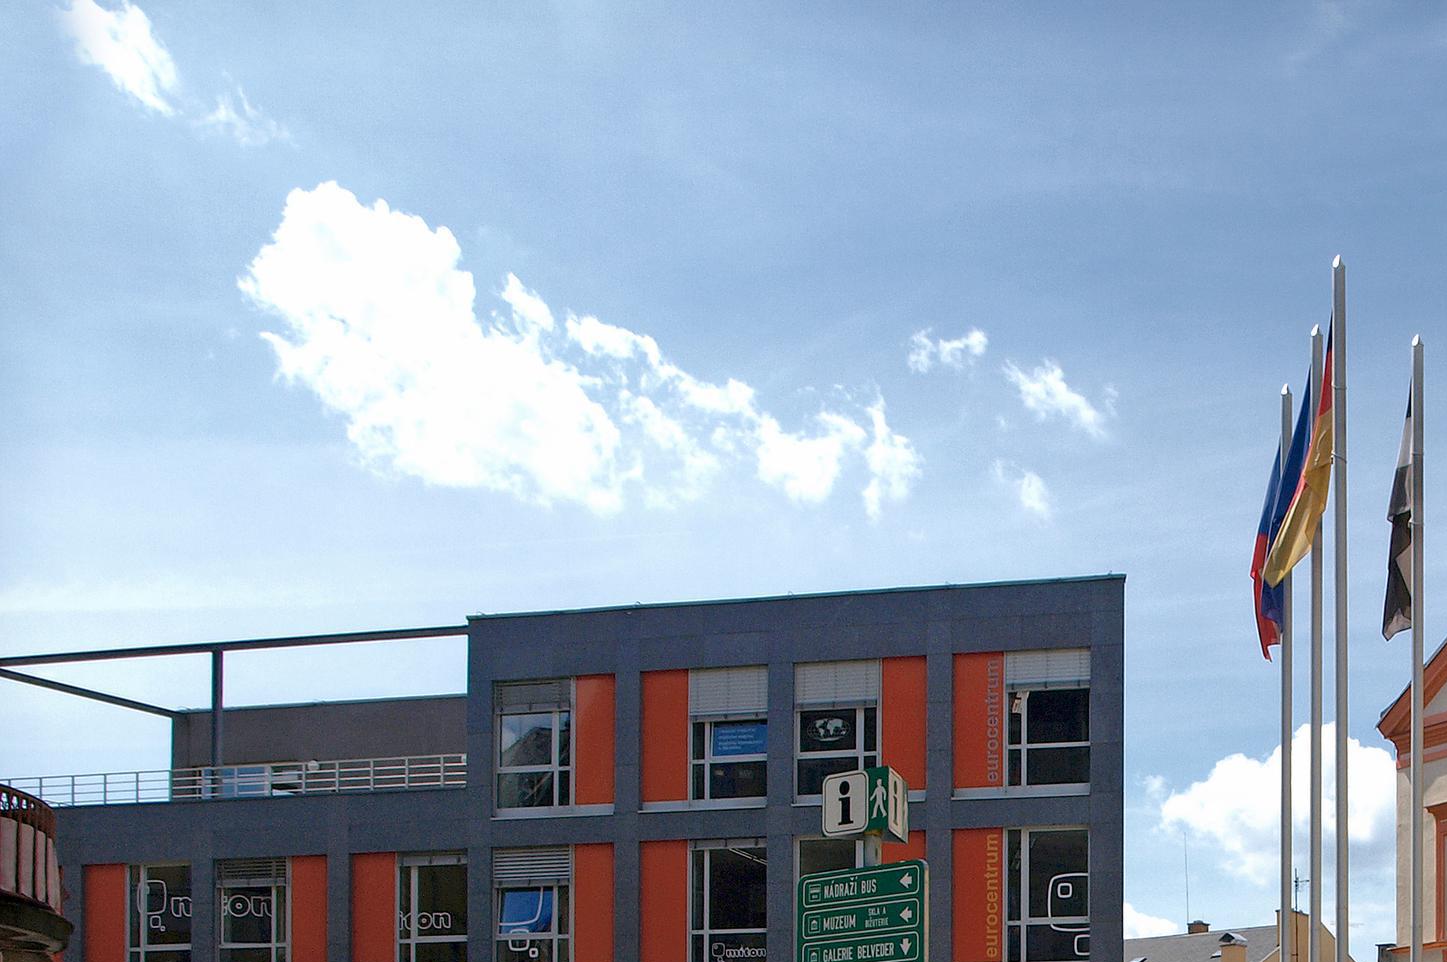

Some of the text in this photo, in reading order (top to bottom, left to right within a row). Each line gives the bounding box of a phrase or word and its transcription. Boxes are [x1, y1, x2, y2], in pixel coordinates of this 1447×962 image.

[986, 656, 999, 784] eurocentrum
[823, 876, 877, 898] NÁDRAŽÍ BUS
[984, 834, 998, 958] eurocentrum
[868, 906, 887, 916] SKLA A
[823, 914, 856, 931] MUZEUM
[726, 946, 767, 958] miton
[823, 942, 895, 962] GALERIE BELVEDER
